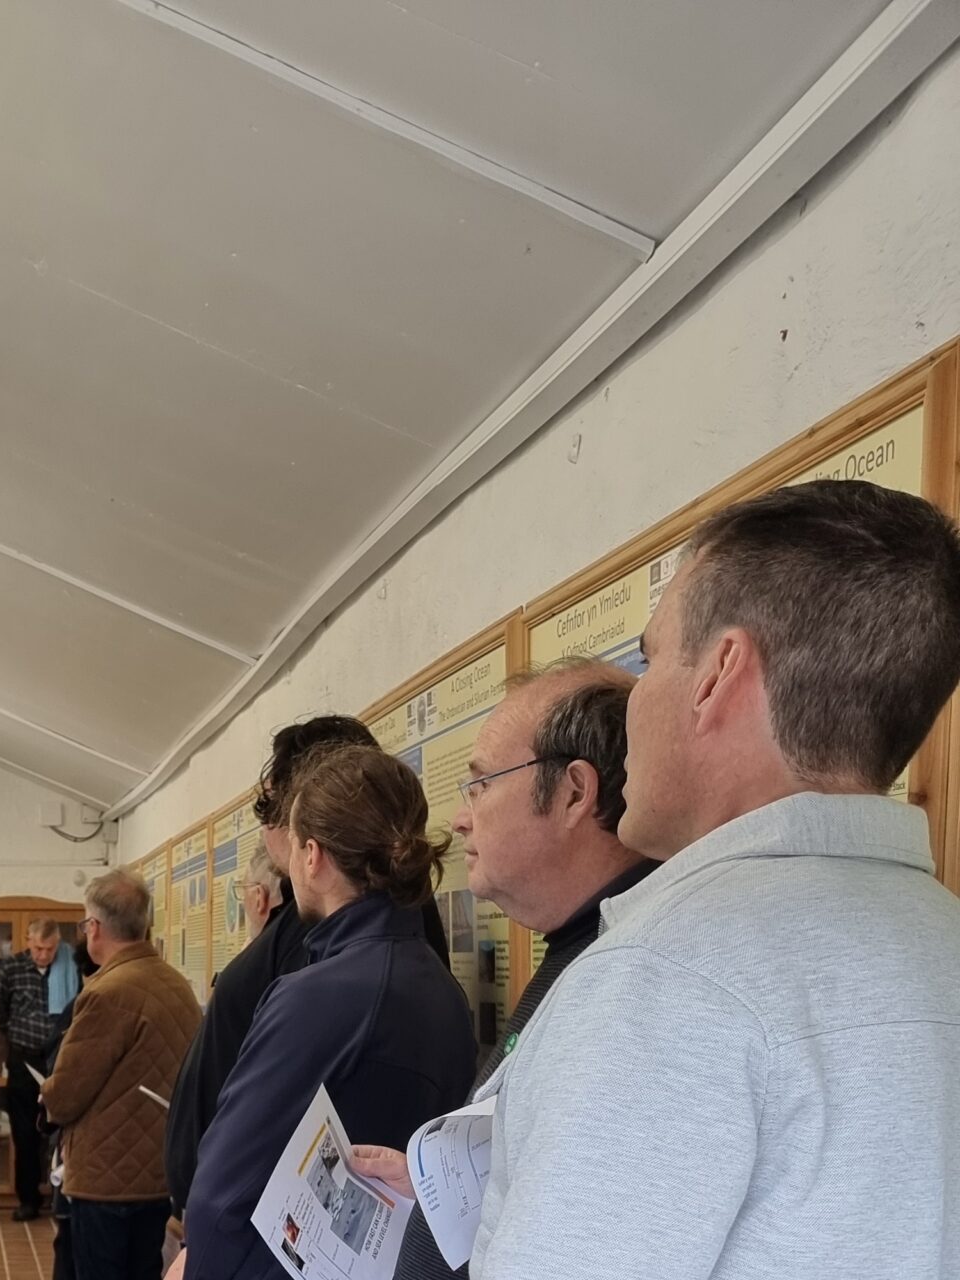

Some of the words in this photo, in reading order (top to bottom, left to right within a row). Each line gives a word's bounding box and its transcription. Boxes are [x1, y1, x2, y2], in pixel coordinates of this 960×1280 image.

[845, 438, 895, 481] Ocean
[556, 608, 586, 638] Cefnfor
[587, 603, 597, 626] yn
[598, 582, 632, 616] Ymledu
[589, 618, 625, 650] Cambriaidd
